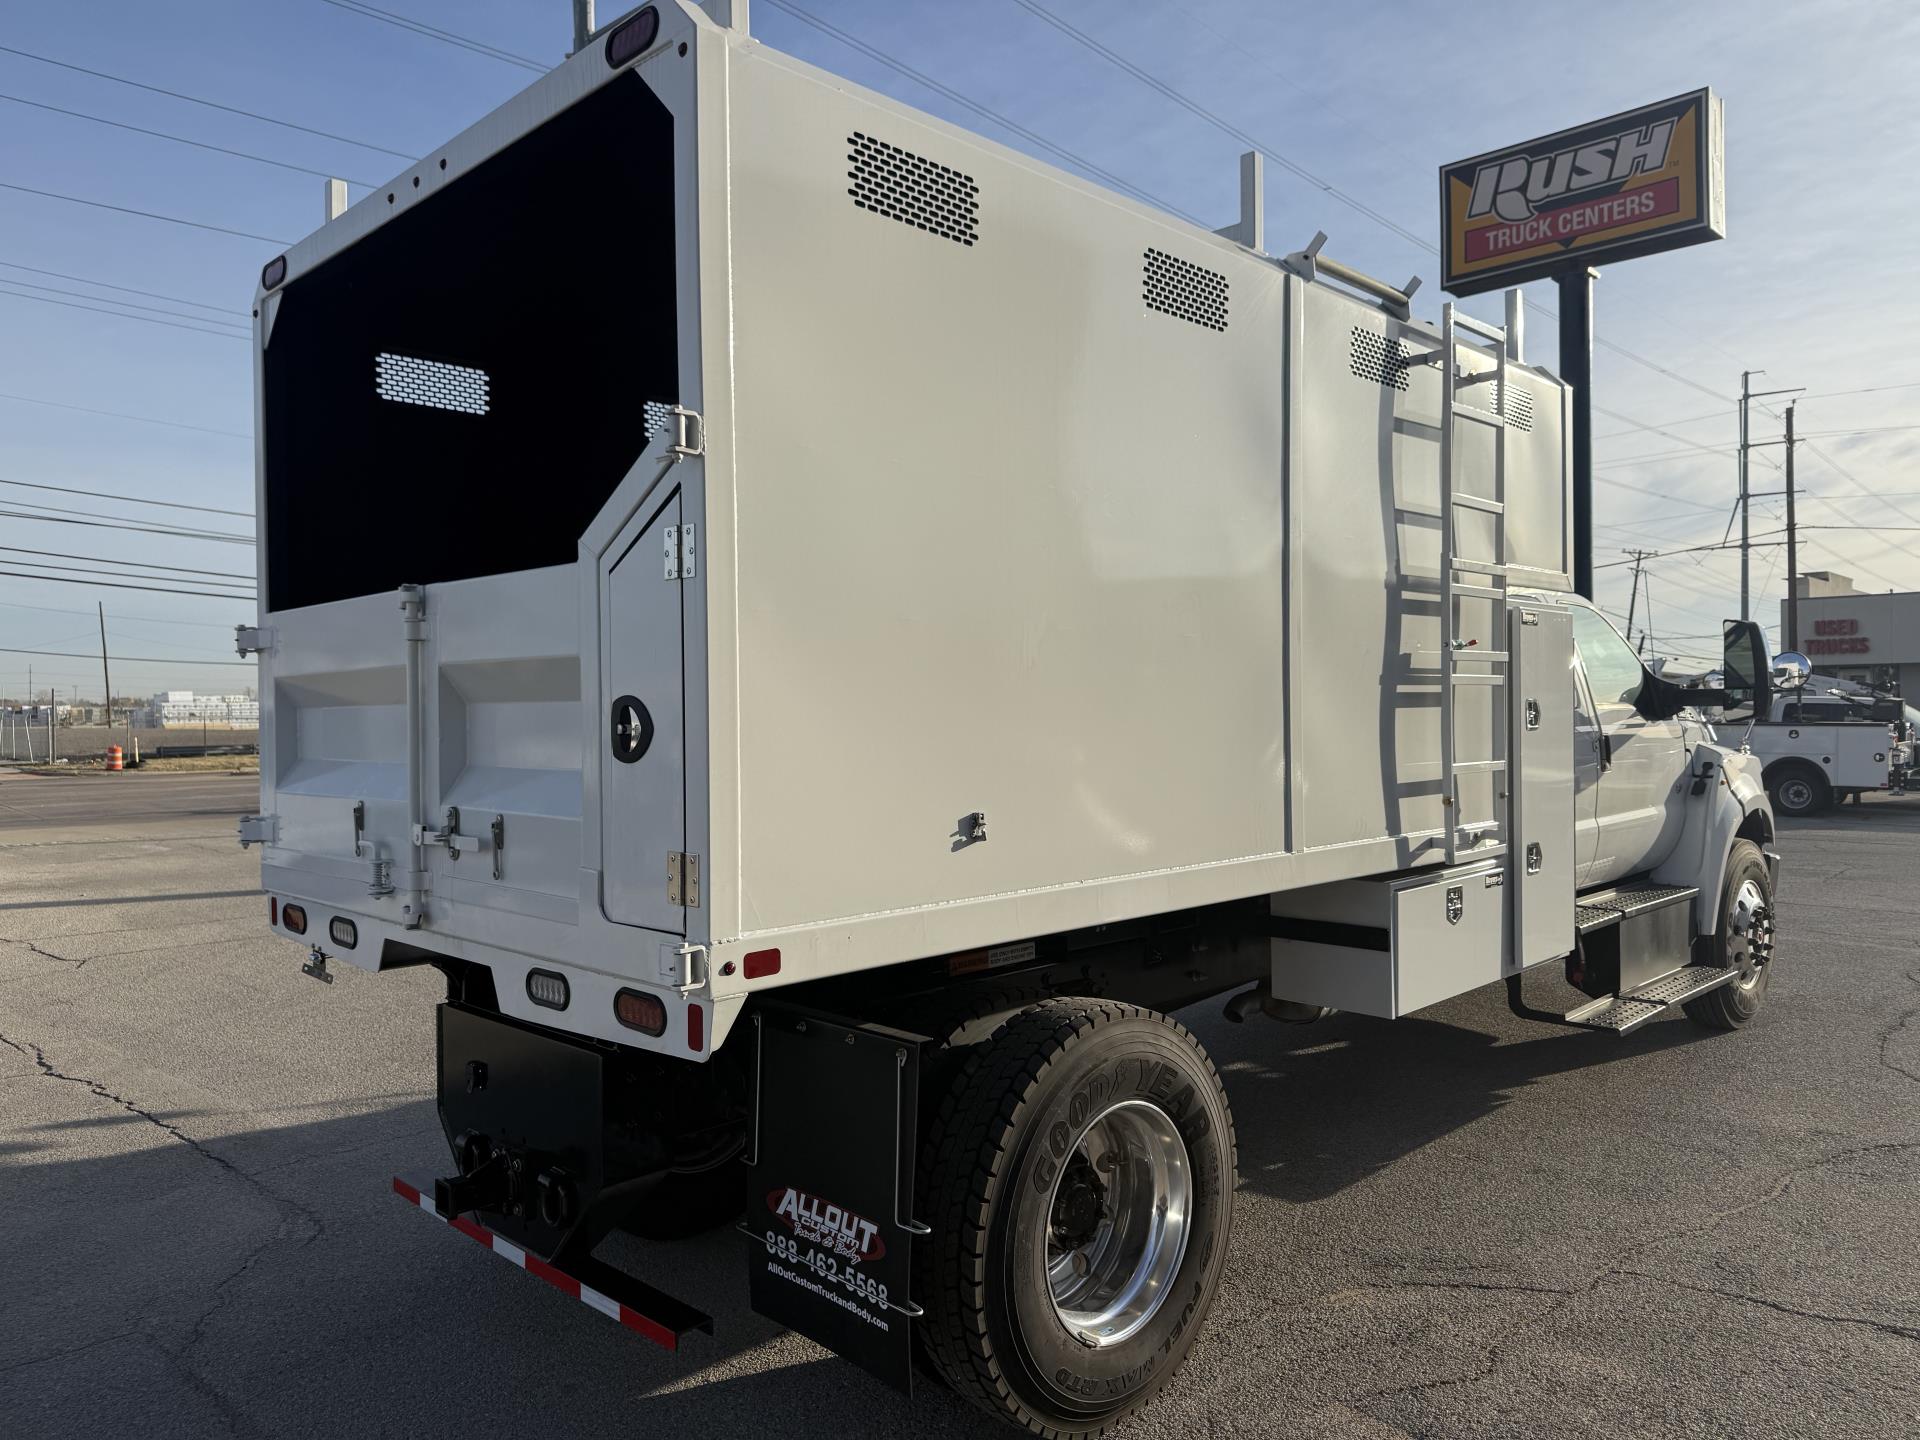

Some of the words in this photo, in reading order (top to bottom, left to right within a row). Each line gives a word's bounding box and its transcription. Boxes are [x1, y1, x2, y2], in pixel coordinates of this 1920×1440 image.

[1485, 217, 1552, 250] TRUCK
[1558, 191, 1655, 233] CENTERS
[1804, 637, 1870, 654] TRUCKS
[767, 1261, 889, 1331] AllOutCustomTruckandBody.com
